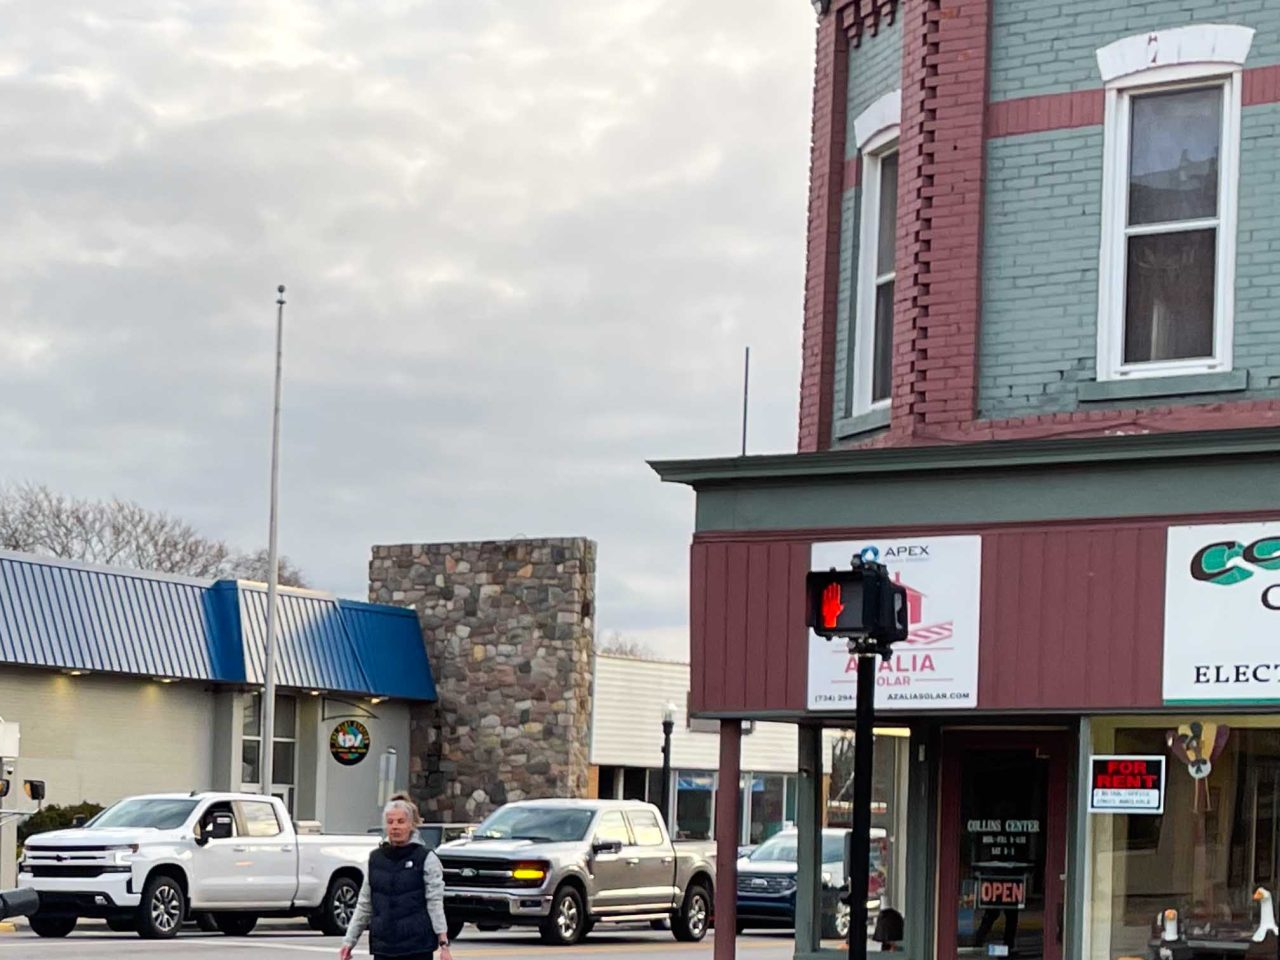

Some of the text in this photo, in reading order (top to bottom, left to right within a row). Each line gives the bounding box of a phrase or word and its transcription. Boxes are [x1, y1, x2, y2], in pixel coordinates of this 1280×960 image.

[884, 545, 929, 556] APEX
[844, 654, 935, 674] AALIA
[876, 675, 911, 687] OLAR
[887, 691, 970, 702] AZALIASOLAR.COM
[1107, 760, 1147, 774] FOR
[1096, 775, 1158, 788] RENT
[967, 819, 1040, 832] COLLINS CENTER
[982, 882, 1024, 902] OPEN
